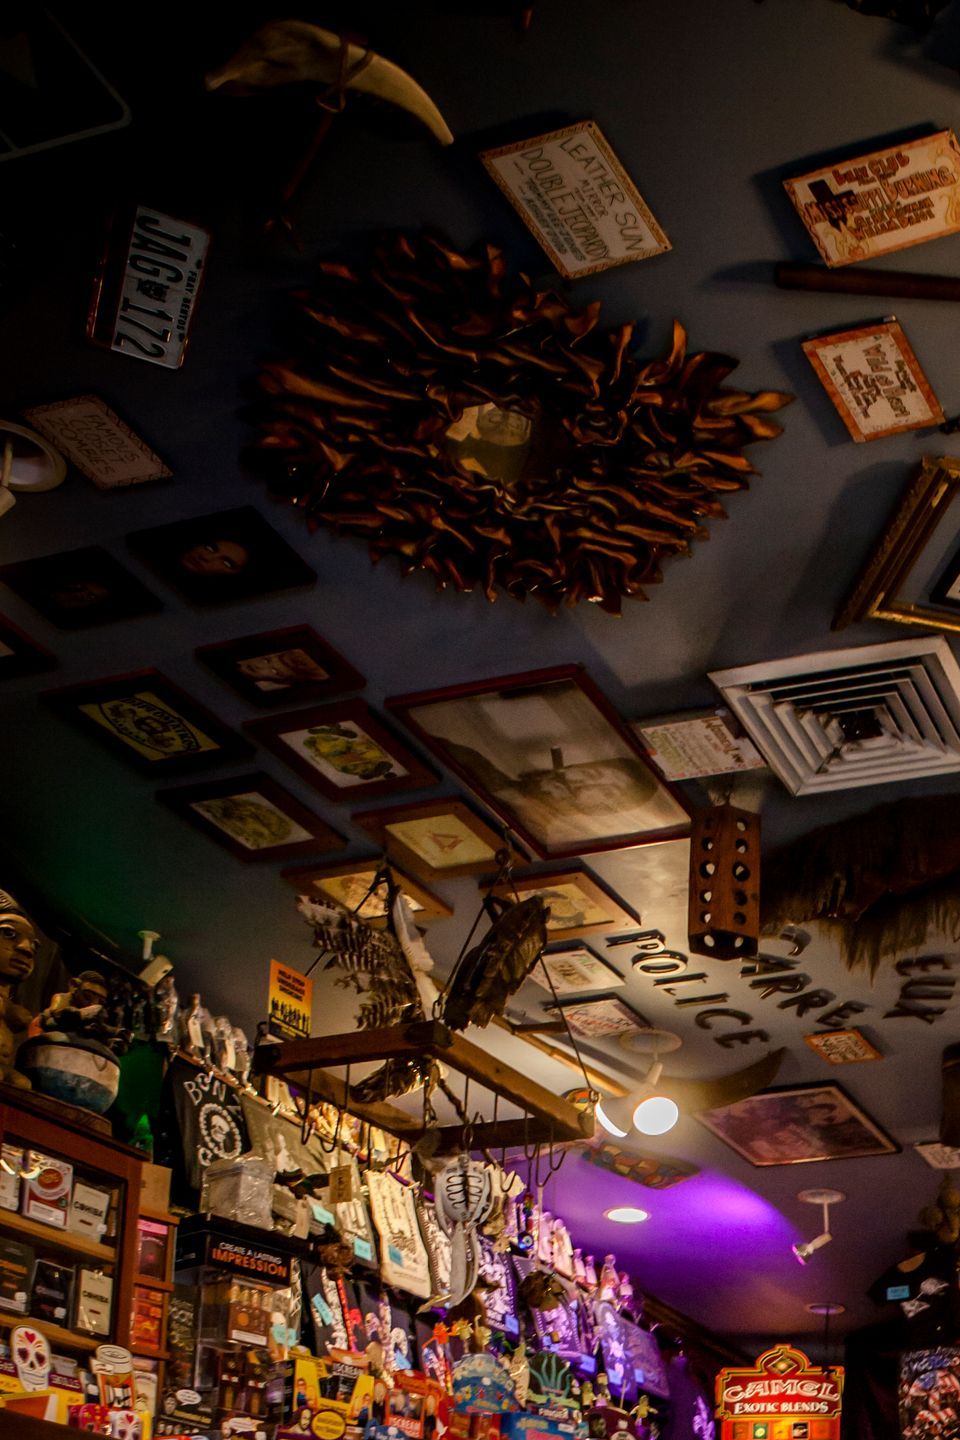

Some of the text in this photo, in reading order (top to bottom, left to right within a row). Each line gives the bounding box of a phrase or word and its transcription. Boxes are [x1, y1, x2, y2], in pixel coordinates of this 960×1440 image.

[520, 146, 575, 207] DOUBLE
[559, 136, 625, 207] LEATHER
[615, 211, 644, 252] SUN
[114, 215, 192, 358] JAG 172
[605, 928, 769, 1050] POLICE
[211, 1247, 288, 1278] IMPRESSION
[722, 1379, 841, 1403] CAMEL
[734, 1401, 829, 1414] EXOTIC BLENDS
